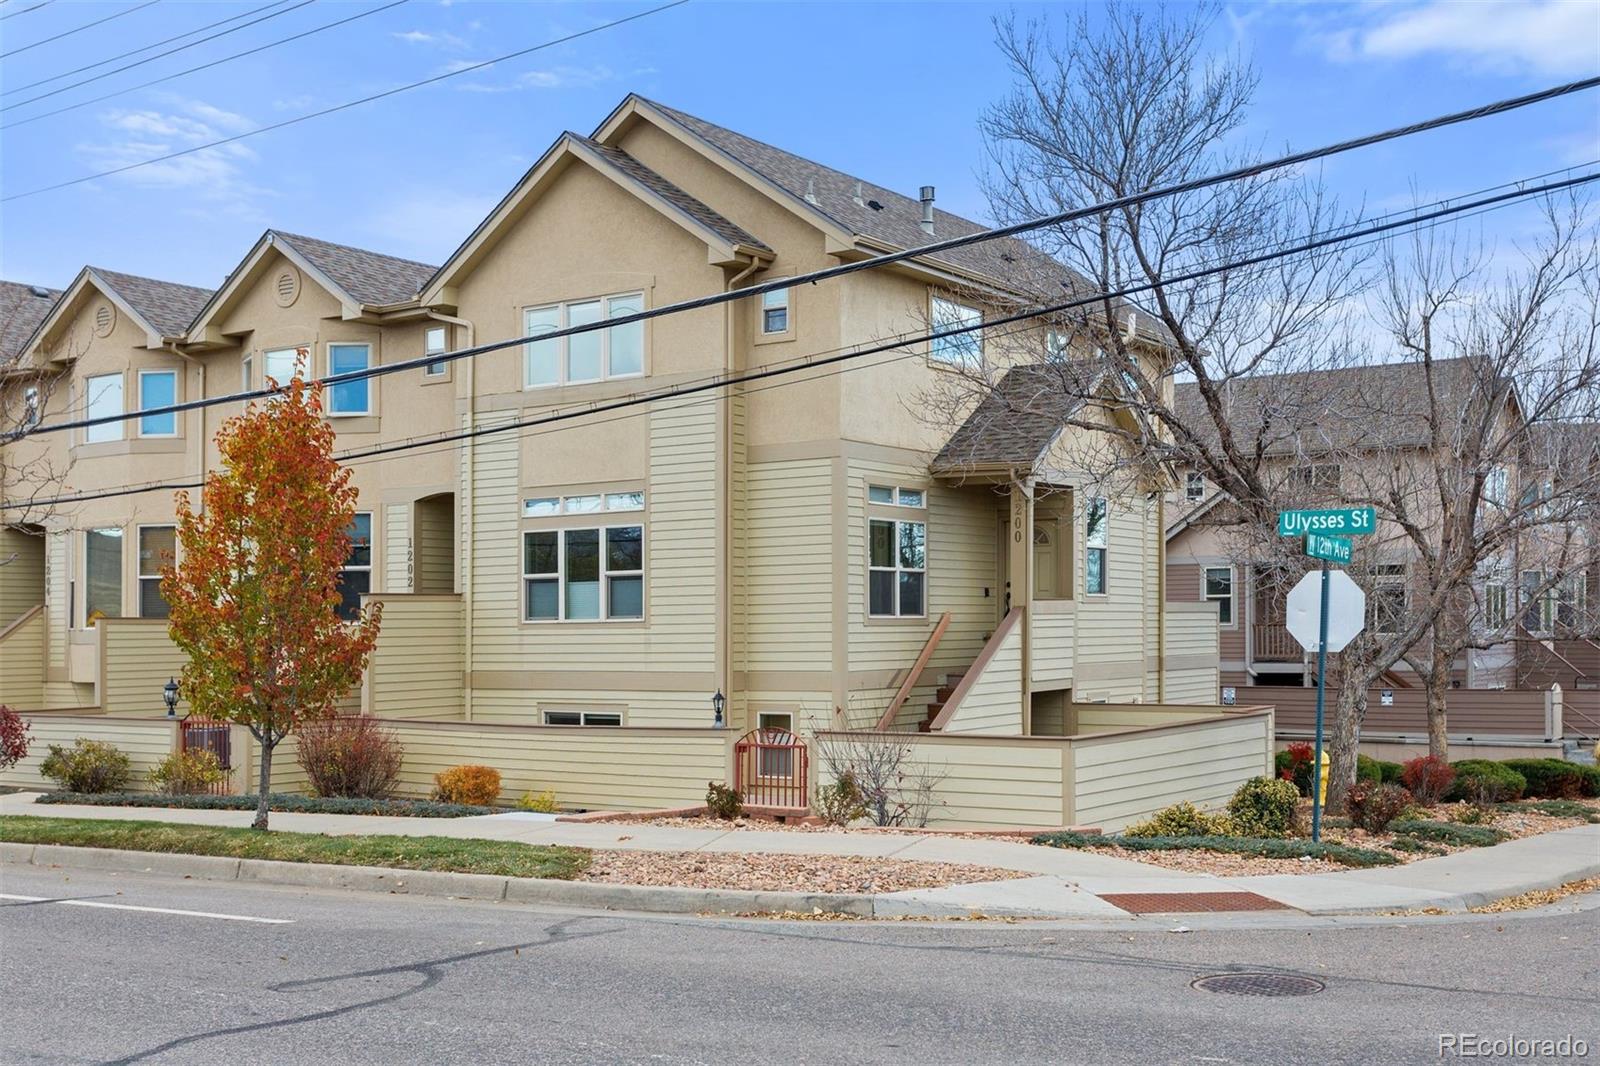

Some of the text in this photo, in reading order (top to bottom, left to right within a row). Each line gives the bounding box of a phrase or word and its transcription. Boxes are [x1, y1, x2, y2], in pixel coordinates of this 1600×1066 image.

[1284, 510, 1369, 531] Ulysses St
[1317, 536, 1332, 556] 12th
[1333, 541, 1349, 560] Ave
